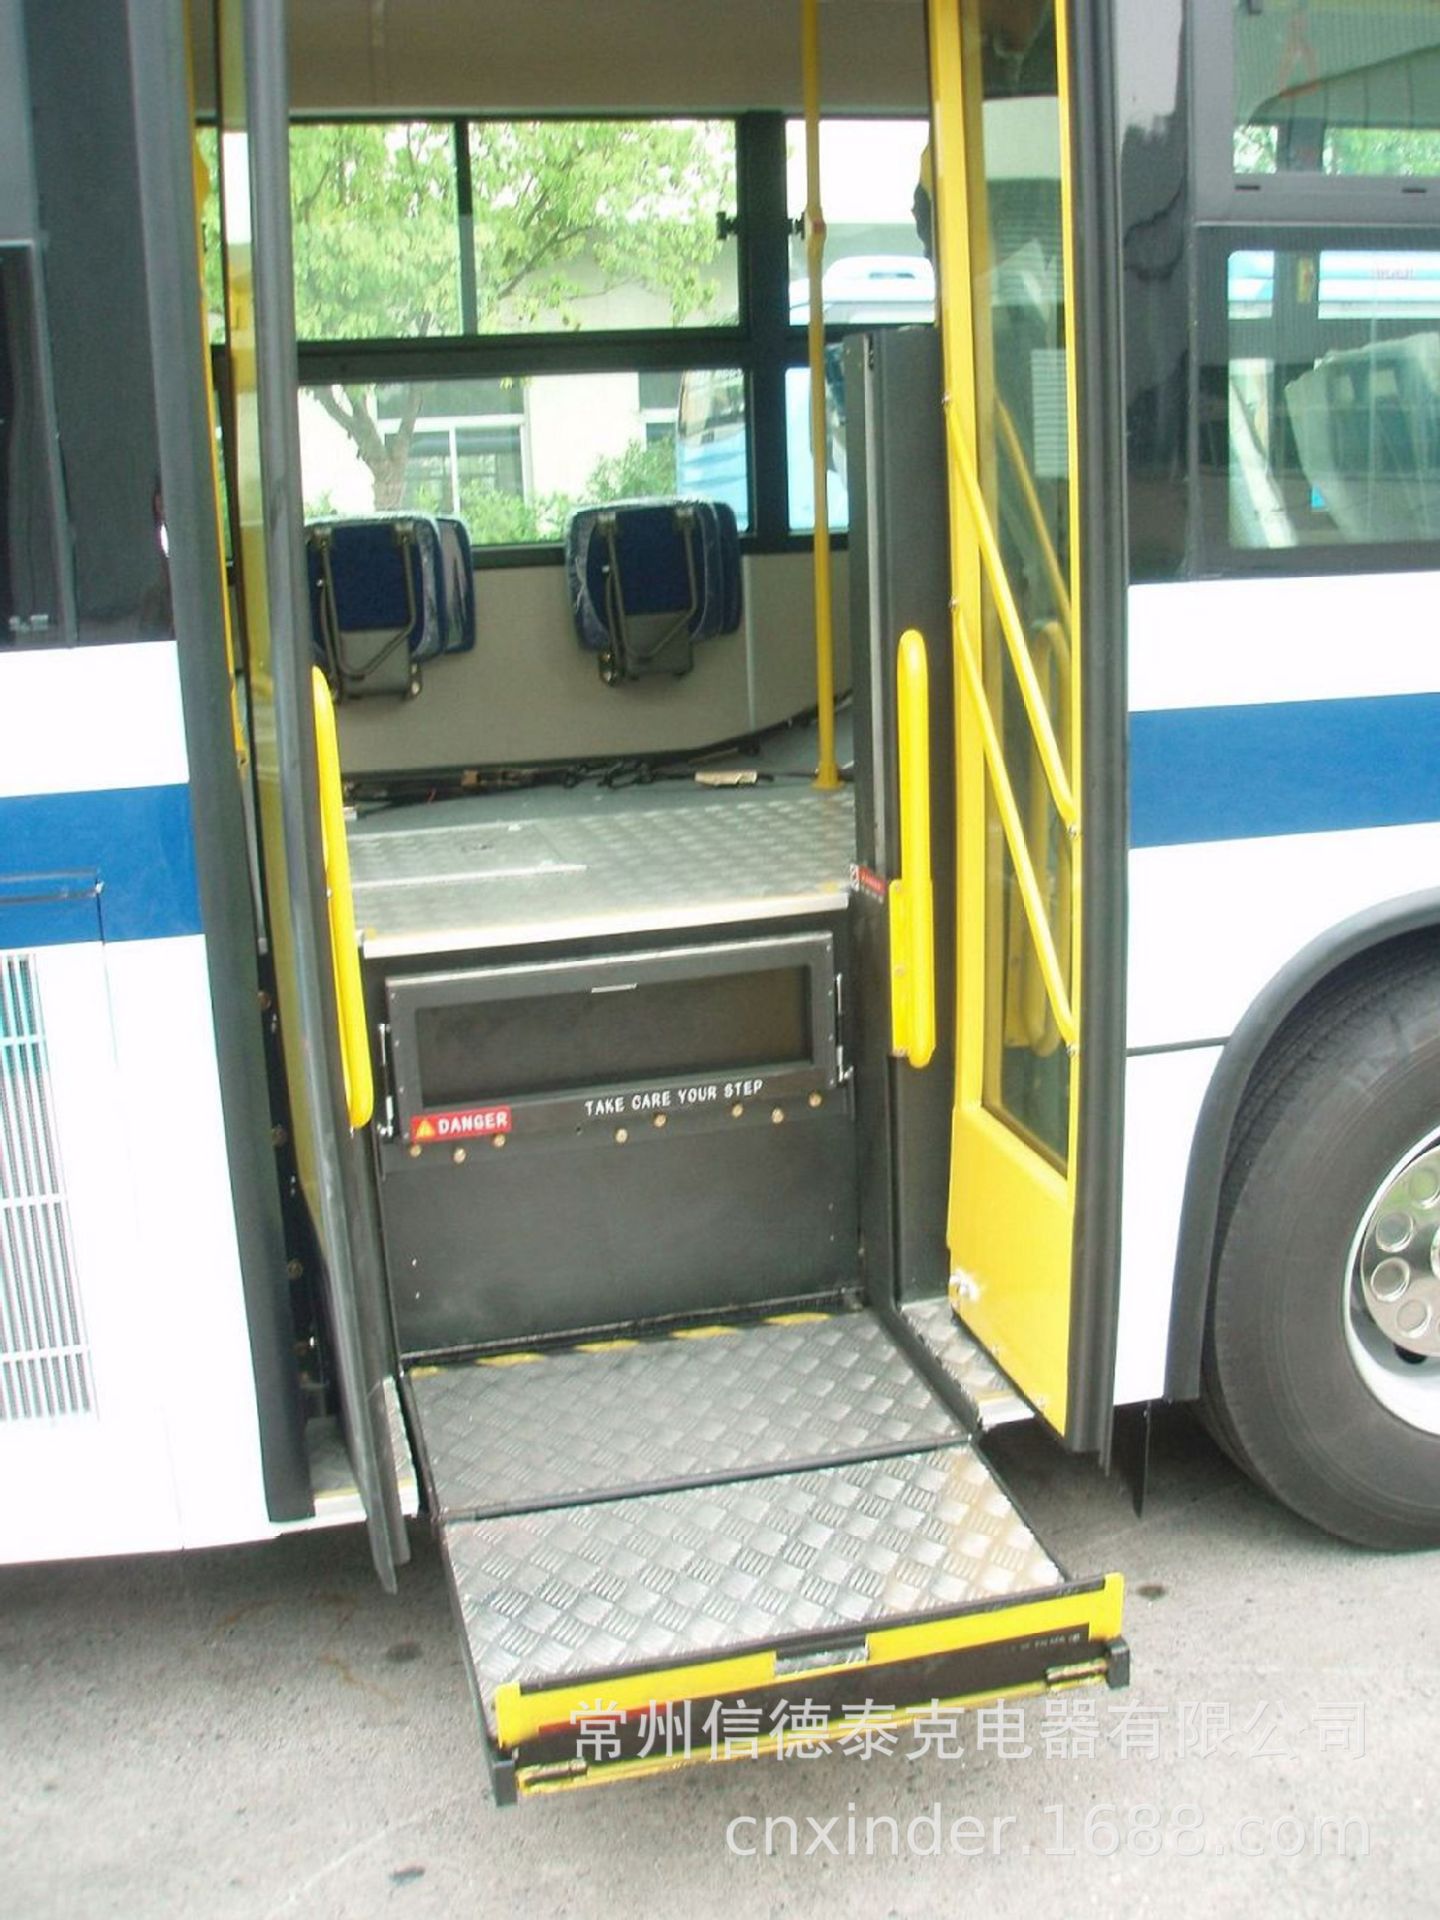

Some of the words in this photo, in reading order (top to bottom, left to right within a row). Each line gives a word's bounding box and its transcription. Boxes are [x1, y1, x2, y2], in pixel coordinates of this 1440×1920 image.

[584, 1097, 625, 1117] TAKE
[631, 1090, 672, 1111] CARE
[677, 1084, 718, 1105] YOUR
[723, 1078, 764, 1099] STEP
[437, 1111, 508, 1135] DANGER
